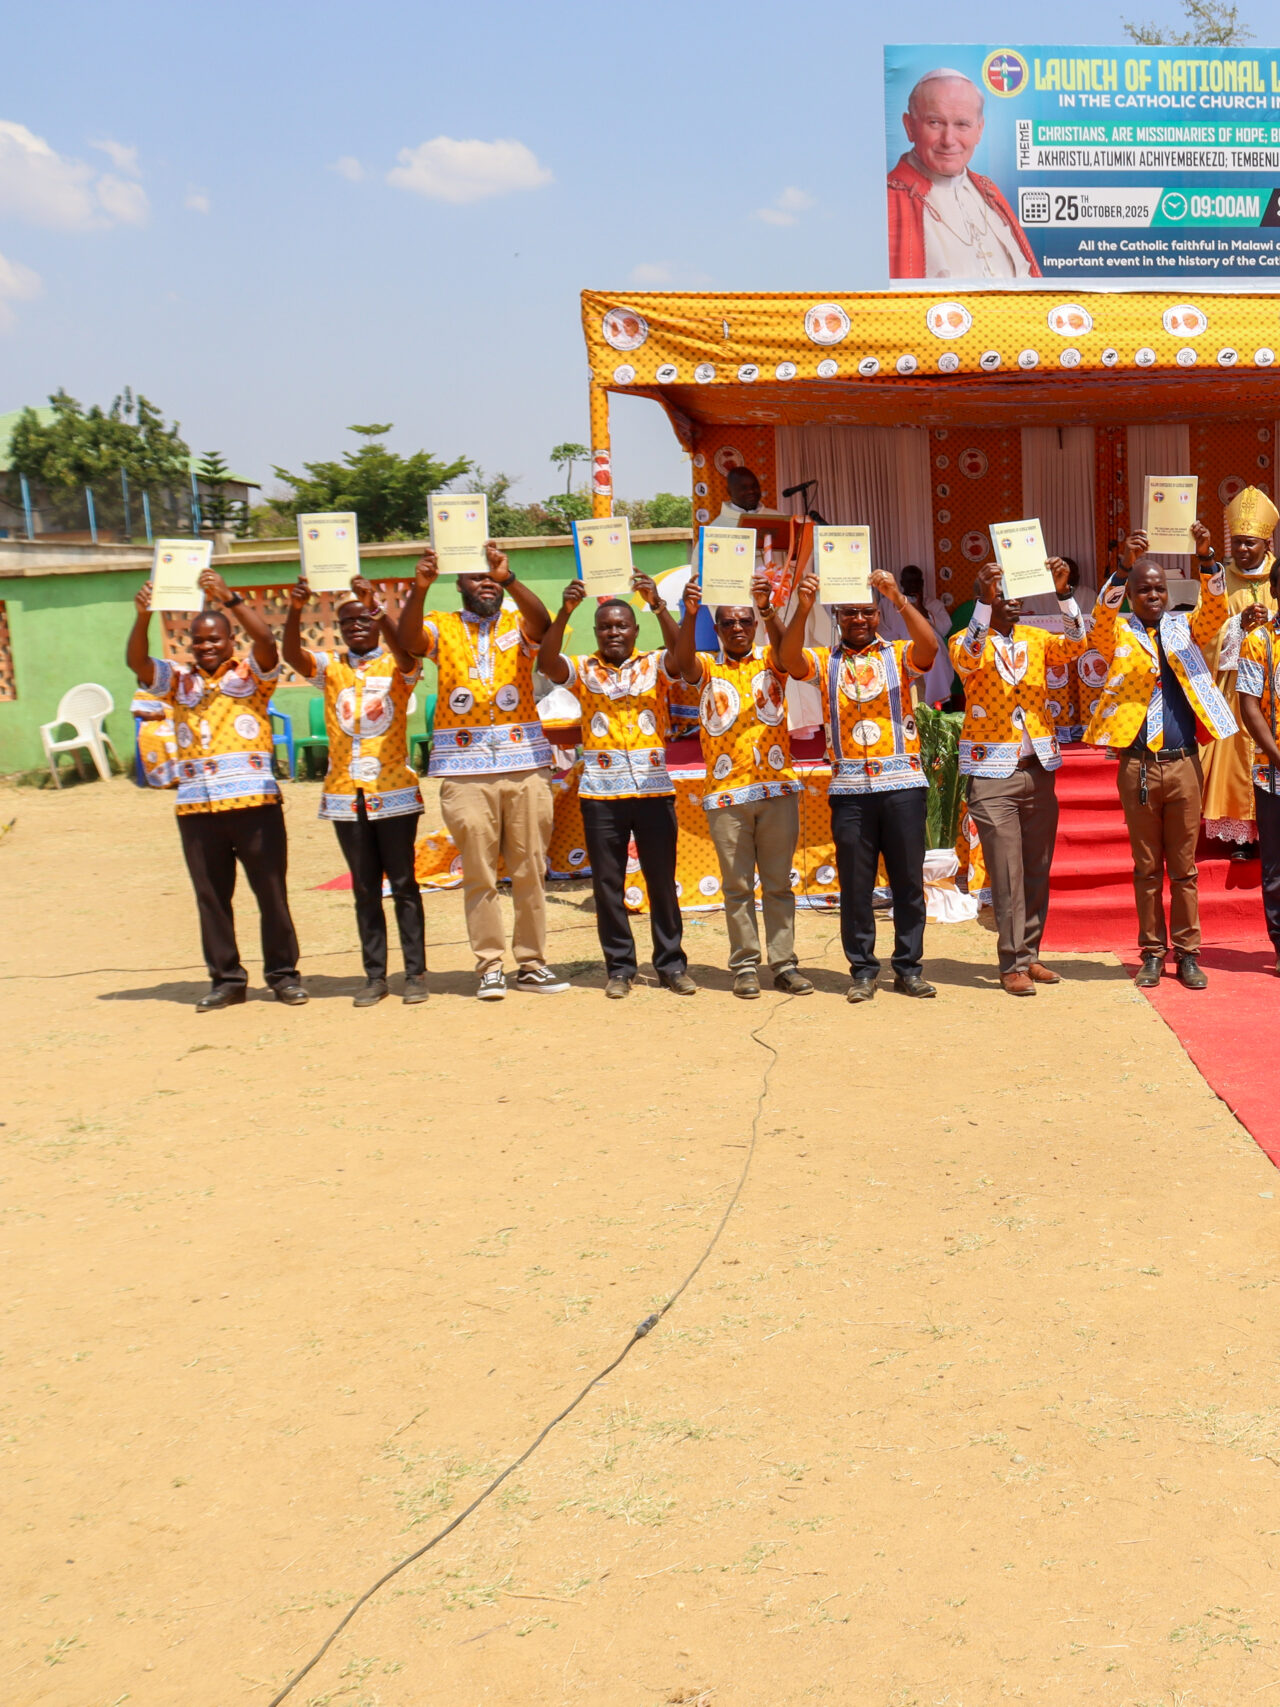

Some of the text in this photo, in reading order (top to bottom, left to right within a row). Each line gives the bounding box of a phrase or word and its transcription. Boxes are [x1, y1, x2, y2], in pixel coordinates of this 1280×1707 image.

[1034, 58, 1117, 91] LAUNCH
[1125, 59, 1152, 91] OF
[1158, 59, 1265, 92] NATIONAL
[1059, 94, 1075, 107] IN
[1079, 94, 1111, 108] THE
[1115, 95, 1196, 108] CATHOLIC
[1200, 95, 1267, 109] CHURCH
[1038, 126, 1108, 143] CHRISTIANS,
[1112, 127, 1133, 142] ARE
[1136, 126, 1215, 142] MISSIONARIES
[1218, 127, 1232, 143] OF
[1236, 128, 1268, 144] HOPE;
[1019, 122, 1030, 168] THEME
[1139, 151, 1228, 168] ACHIYEMBEKEZO;
[1080, 195, 1089, 203] TH
[1190, 195, 1260, 218] 09:00AM
[1055, 195, 1078, 221] 25
[1078, 240, 1095, 251] All
[1097, 240, 1117, 251] the
[1120, 240, 1169, 251] Catholic
[1171, 240, 1215, 251] faithful
[1217, 240, 1228, 251] in
[1231, 240, 1274, 251] Malawi
[1043, 256, 1104, 269] important
[1106, 257, 1140, 266] event
[1142, 256, 1153, 266] in
[1155, 256, 1176, 266] the
[1178, 256, 1219, 269] history
[1222, 256, 1235, 266] of
[1237, 256, 1256, 266] the
